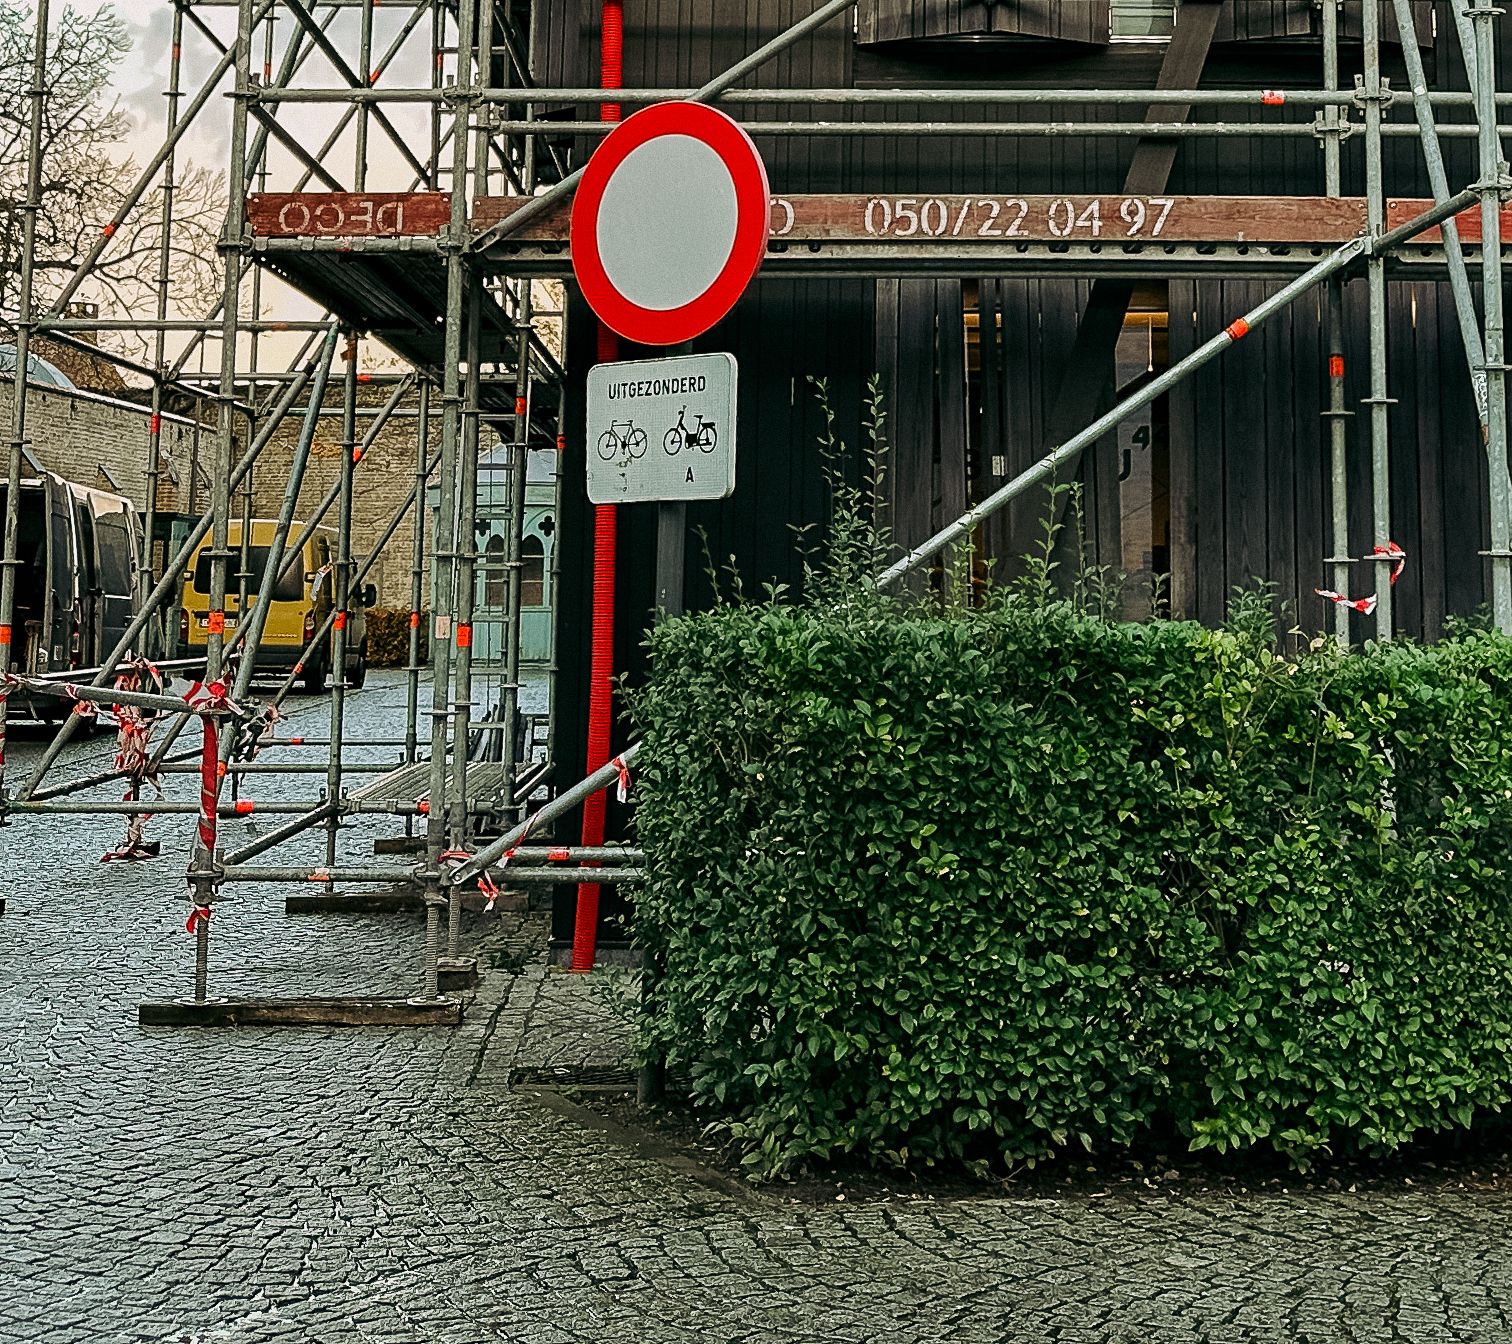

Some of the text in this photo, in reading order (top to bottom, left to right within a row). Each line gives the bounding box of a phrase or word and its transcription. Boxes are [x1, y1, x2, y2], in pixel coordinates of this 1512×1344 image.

[279, 201, 404, 235] DECO
[864, 198, 1175, 238] 050/22 04 97
[609, 376, 706, 399] UITGEZONDERD
[685, 467, 694, 482] A
